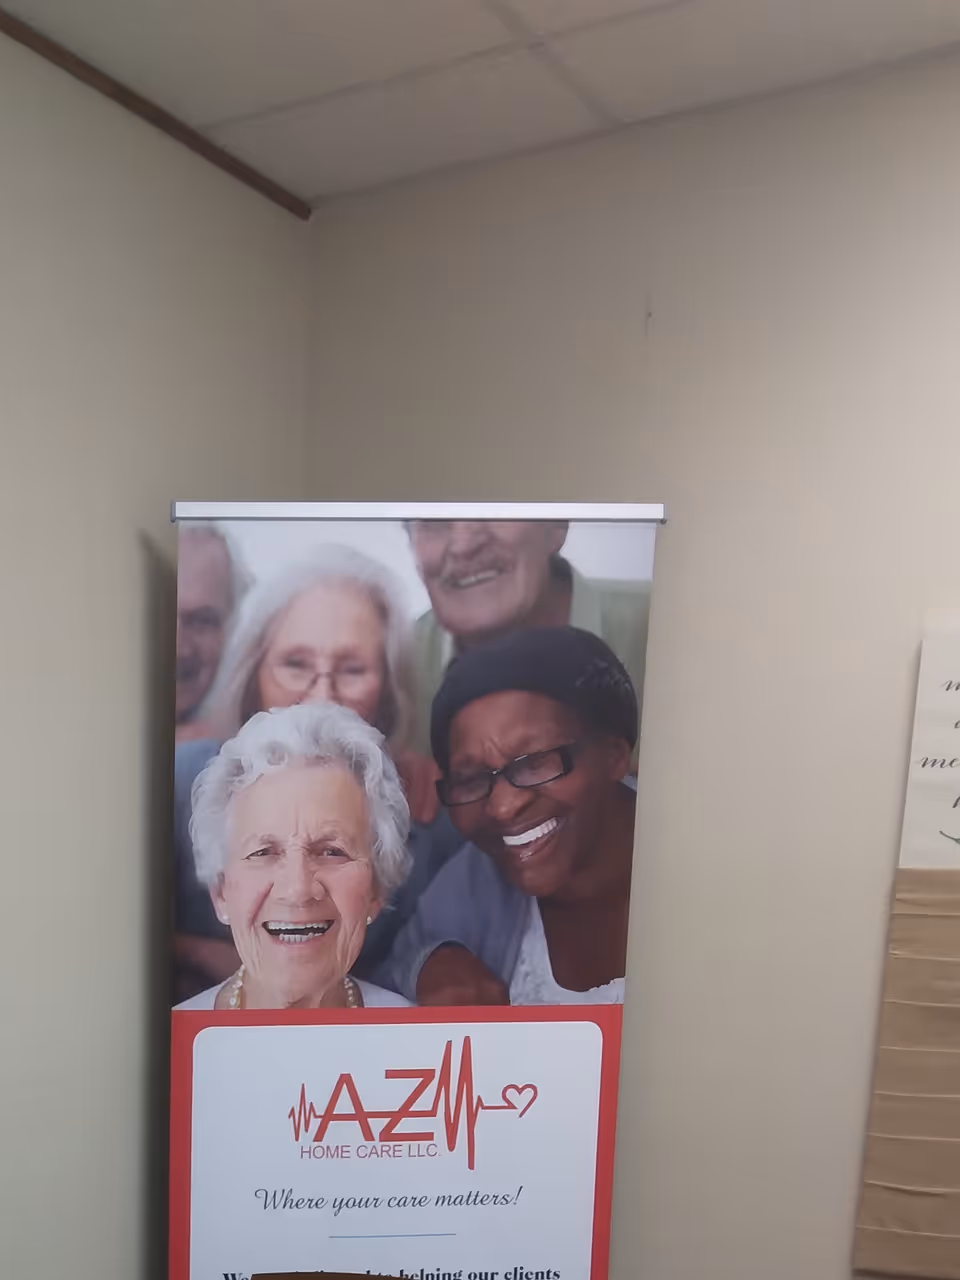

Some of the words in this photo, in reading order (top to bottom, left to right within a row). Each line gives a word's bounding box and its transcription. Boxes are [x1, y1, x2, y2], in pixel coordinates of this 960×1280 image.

[300, 1145, 351, 1160] HOME
[356, 1144, 403, 1159] CARE
[254, 1188, 328, 1210] Where
[332, 1196, 384, 1217] your
[387, 1193, 432, 1208] care
[434, 1185, 523, 1207] matters!
[504, 1266, 561, 1280] clients
